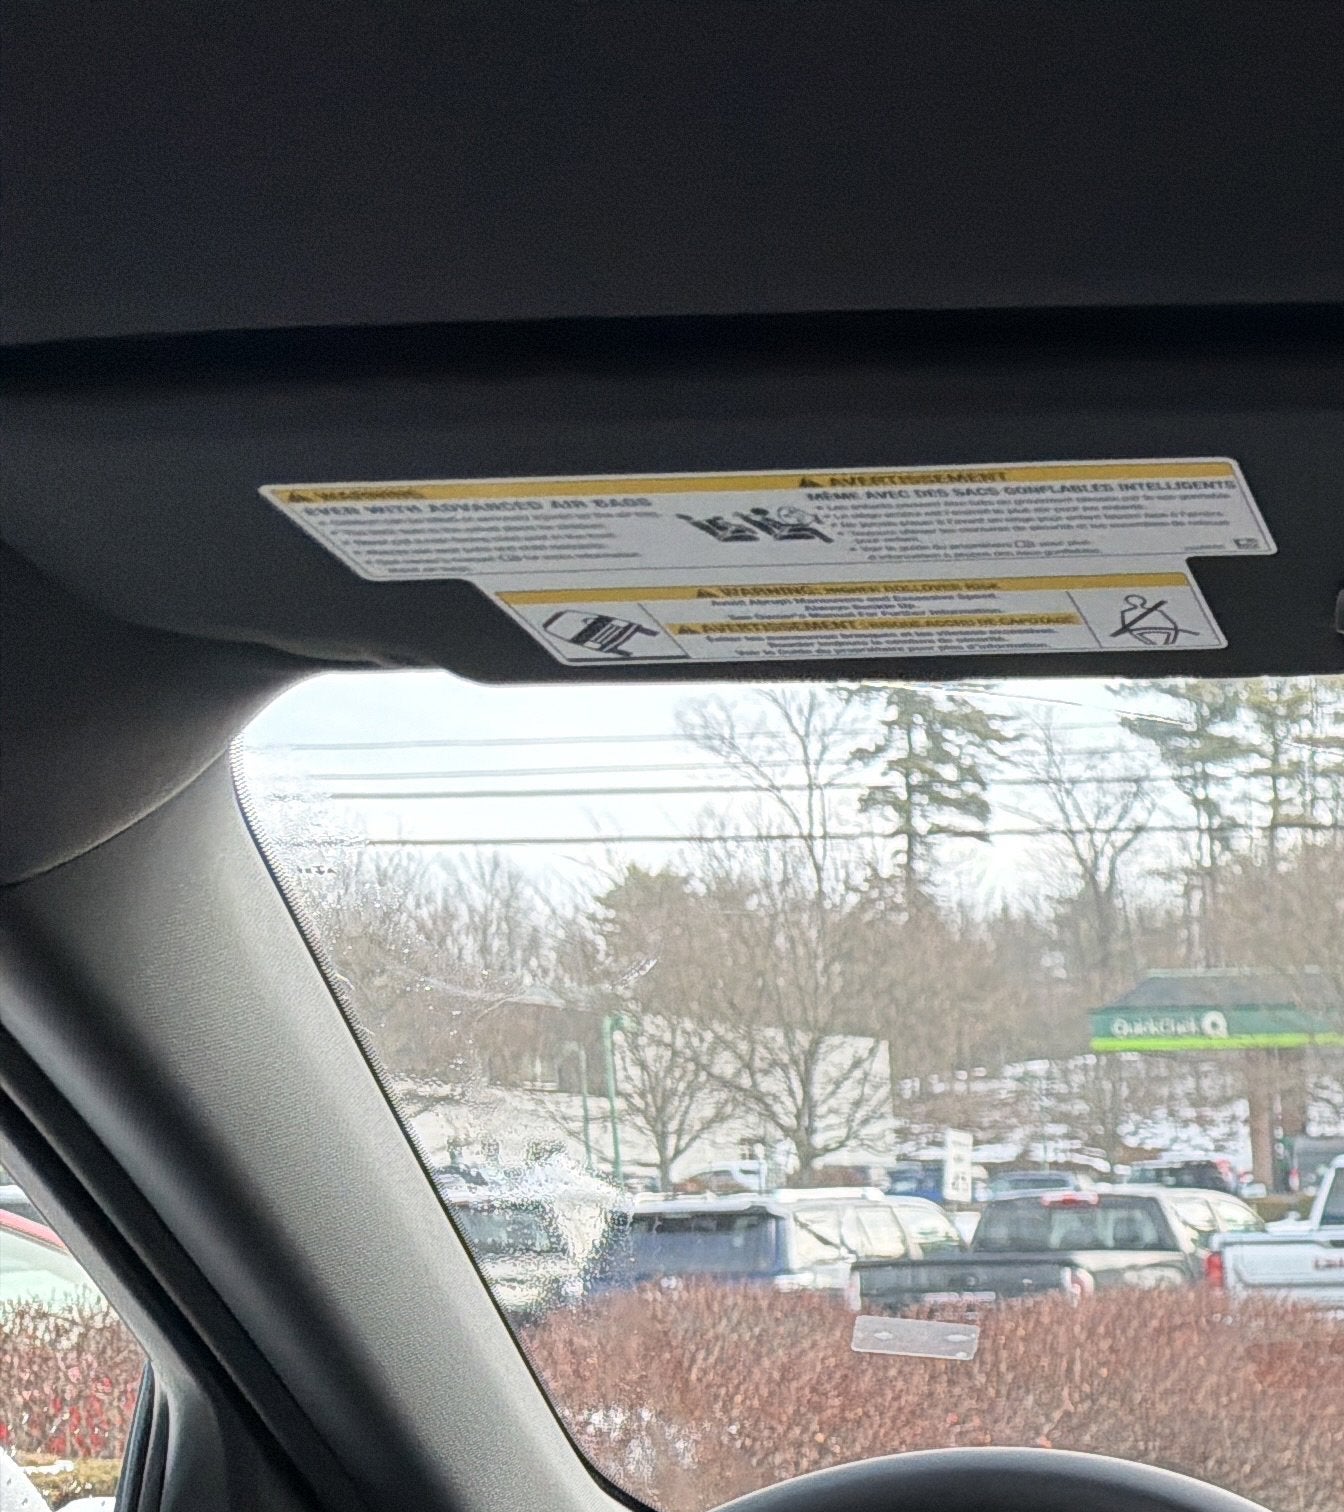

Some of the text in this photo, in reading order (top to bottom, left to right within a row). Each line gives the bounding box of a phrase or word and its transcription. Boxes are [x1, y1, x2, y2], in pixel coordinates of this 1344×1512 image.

[866, 480, 1237, 499] AVEC DES SACS GONFLABLES INTELLIGENTS
[364, 504, 423, 514] WITH
[429, 501, 544, 513] ADVANCED
[551, 500, 588, 509] AIR
[593, 498, 652, 508] BAGS
